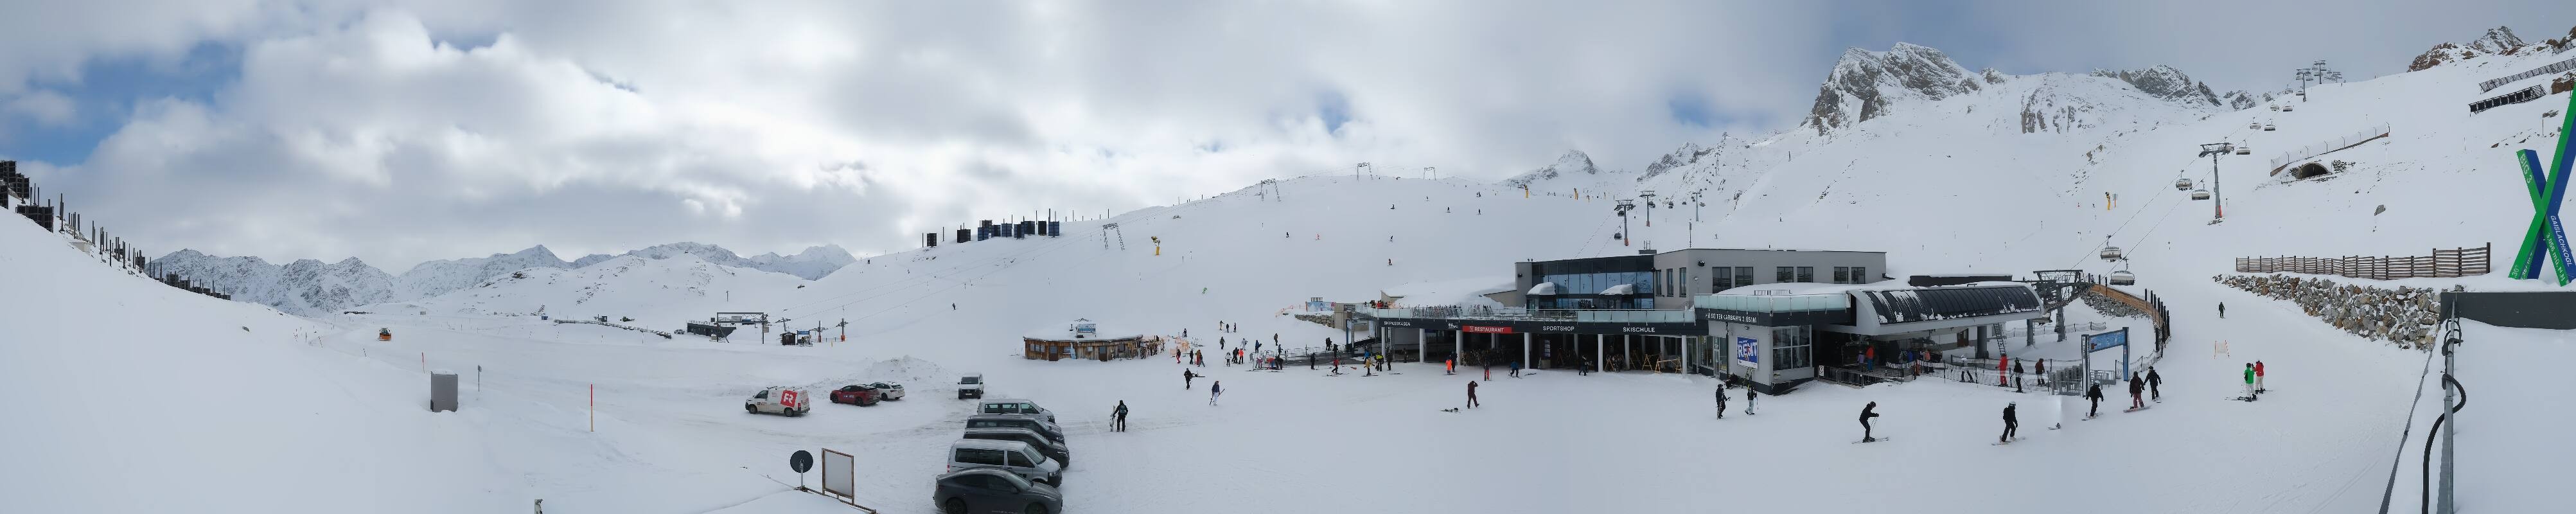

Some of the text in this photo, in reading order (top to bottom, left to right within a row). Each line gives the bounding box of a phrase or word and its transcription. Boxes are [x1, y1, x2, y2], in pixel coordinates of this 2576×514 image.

[2519, 153, 2533, 184] BIG 3
[2550, 215, 2573, 267] GAISLACHKOGL
[1737, 342, 1758, 358] RENT
